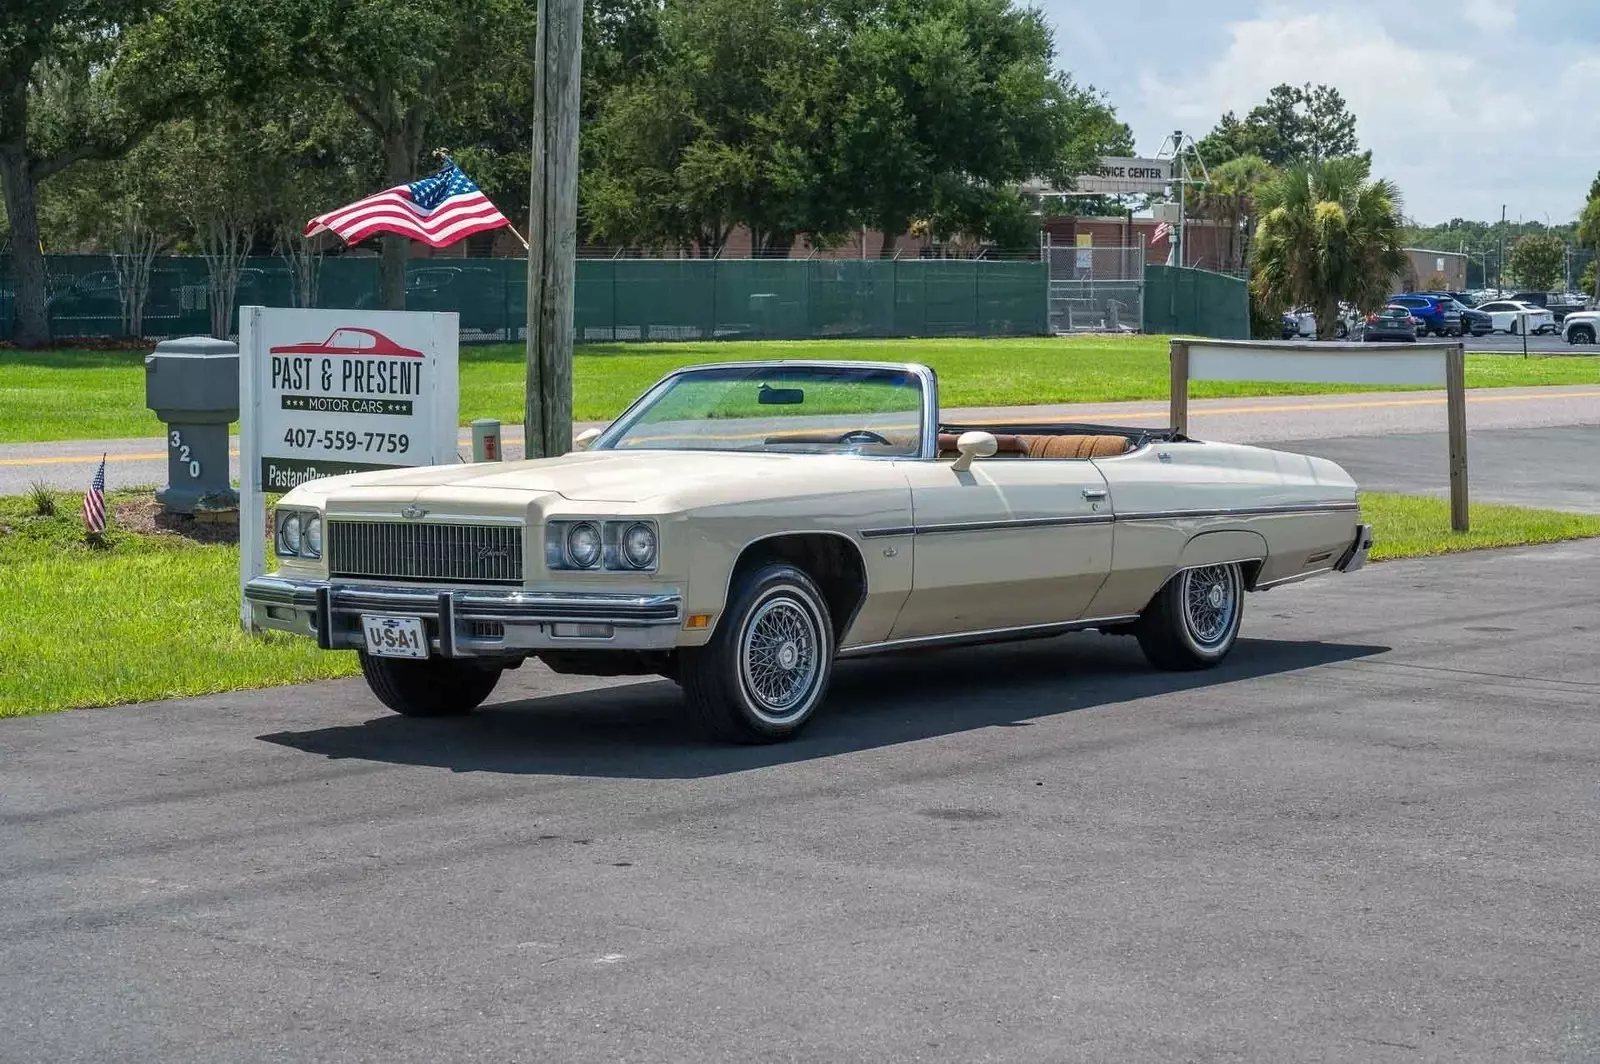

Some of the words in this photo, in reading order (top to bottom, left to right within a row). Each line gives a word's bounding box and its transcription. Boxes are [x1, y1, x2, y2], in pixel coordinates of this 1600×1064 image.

[1128, 167, 1161, 179] CENTER
[272, 356, 312, 391] PAST
[321, 358, 332, 391] &
[342, 359, 422, 395] PRESENT
[309, 398, 349, 412] MOTOR
[352, 400, 384, 413] CARS
[284, 428, 409, 453] 407-559-7759
